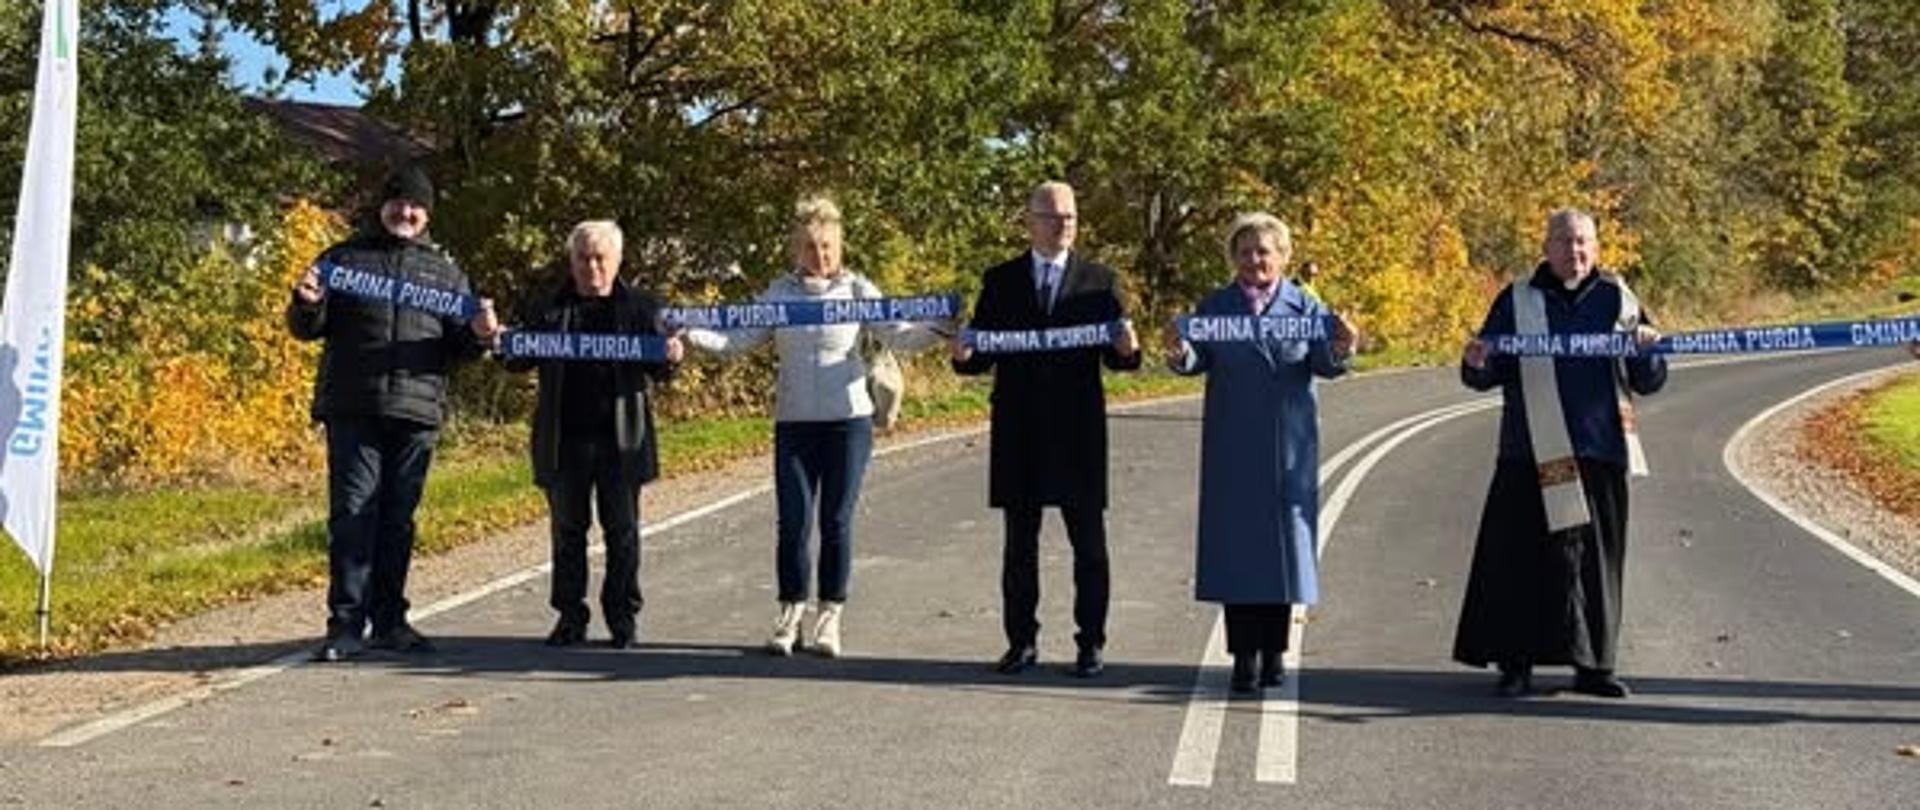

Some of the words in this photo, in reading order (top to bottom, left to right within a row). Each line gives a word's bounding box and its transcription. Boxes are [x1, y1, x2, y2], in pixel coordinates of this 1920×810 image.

[329, 265, 393, 301] GMINA
[400, 281, 464, 317] PURDA
[727, 304, 790, 328] PURDA
[822, 300, 885, 323] GMINA
[889, 296, 951, 320] PURDA
[976, 328, 1041, 353] GMINA
[1046, 323, 1111, 348] PURDA
[1188, 315, 1254, 342] GMINA
[1260, 315, 1327, 342] PURDA
[1672, 331, 1741, 353] GMINA
[1746, 326, 1816, 351] PURDA
[1852, 319, 1920, 345] GMINA
[511, 333, 574, 358] GMINA
[580, 335, 643, 360] PURDA
[1500, 333, 1565, 355] GMINA
[1570, 332, 1638, 357] PURDA
